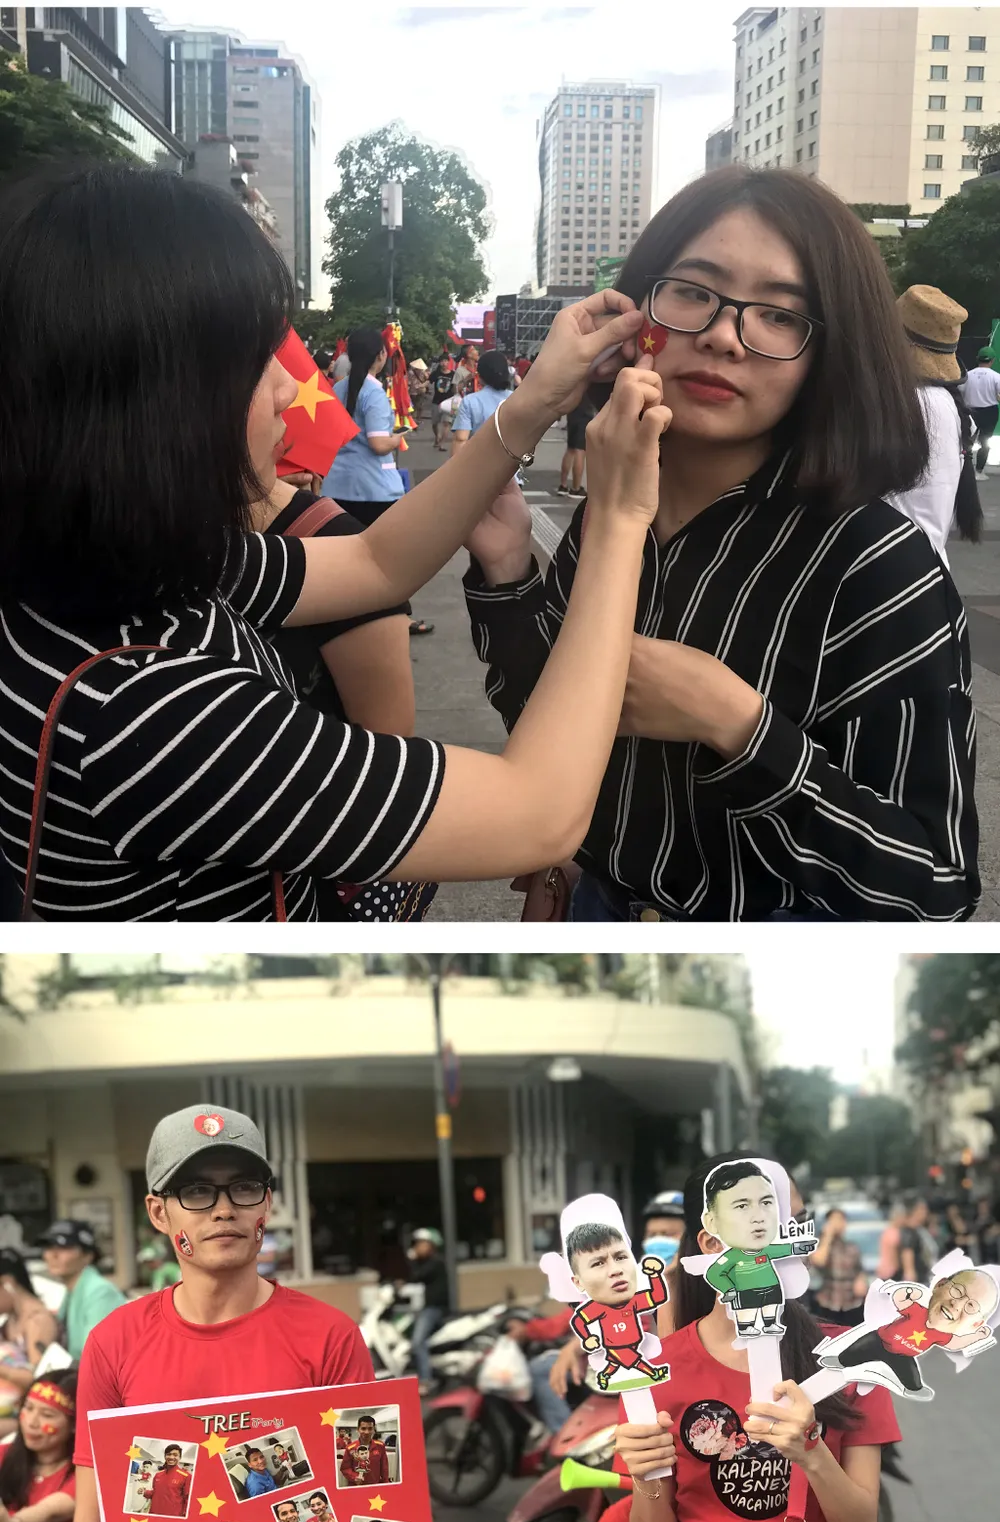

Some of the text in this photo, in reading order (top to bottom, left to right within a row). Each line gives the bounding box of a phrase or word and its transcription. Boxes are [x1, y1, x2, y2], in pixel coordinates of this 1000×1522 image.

[612, 1321, 627, 1334] 19
[199, 1411, 285, 1434] TREE Party
